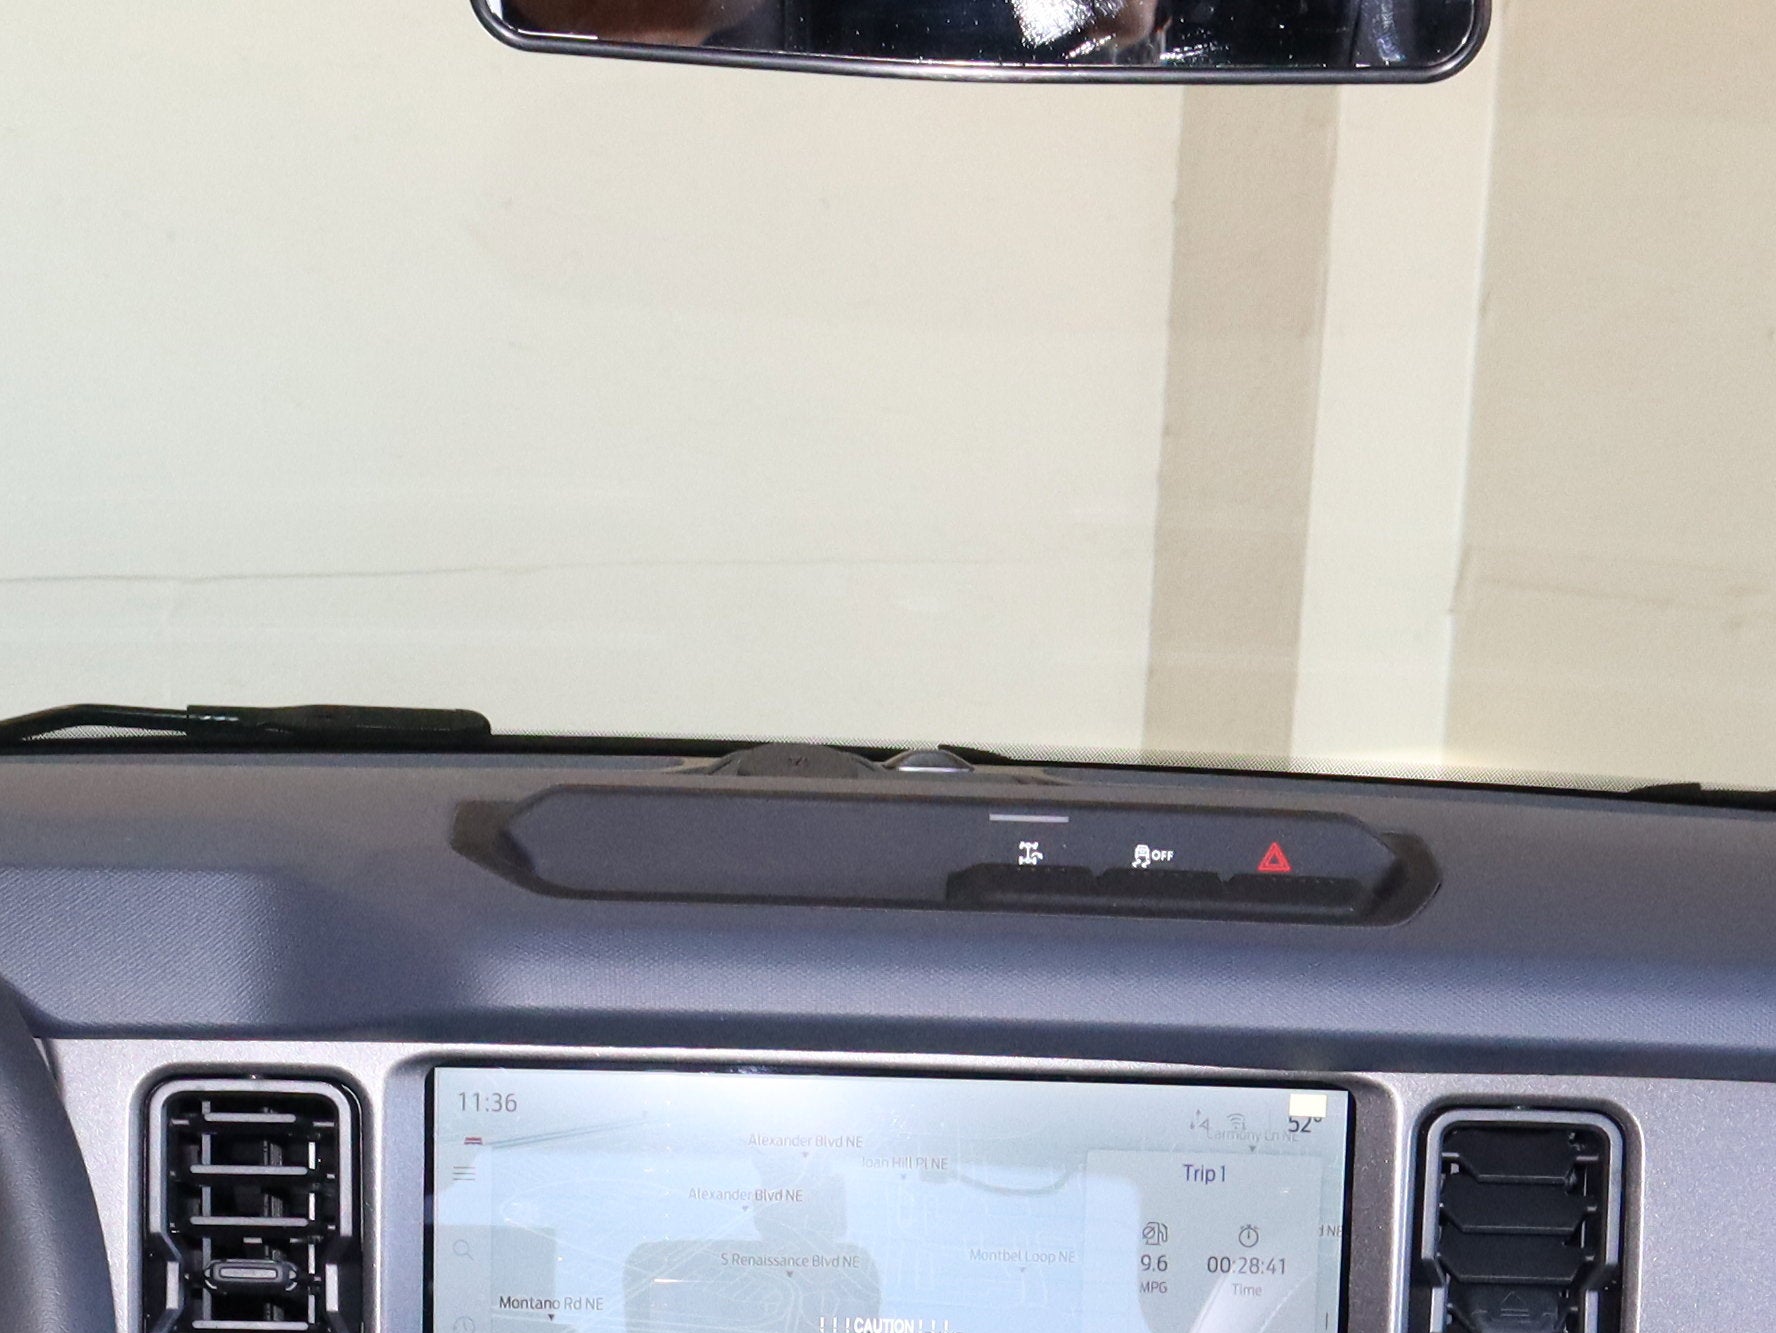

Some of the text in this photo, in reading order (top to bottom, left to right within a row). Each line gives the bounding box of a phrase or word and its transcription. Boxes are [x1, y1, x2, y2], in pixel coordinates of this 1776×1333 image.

[1152, 849, 1174, 862] OFF
[458, 1092, 518, 1113] 11:36
[748, 1134, 863, 1148] Alexander Blvd NE
[931, 1157, 949, 1170] NE
[1183, 1163, 1226, 1184] Trip 1
[689, 1188, 803, 1201] Alexander Blvd NE
[720, 1253, 860, 1268] S Renaissance Blvd NE
[1025, 1250, 1056, 1264] Loop
[1058, 1251, 1075, 1263] NE
[1140, 1254, 1168, 1272] 9.6
[1207, 1256, 1286, 1275] 00:28:41
[1139, 1281, 1168, 1294] MPG
[1232, 1283, 1262, 1296] Time
[499, 1296, 604, 1310] Montano Rd NE
